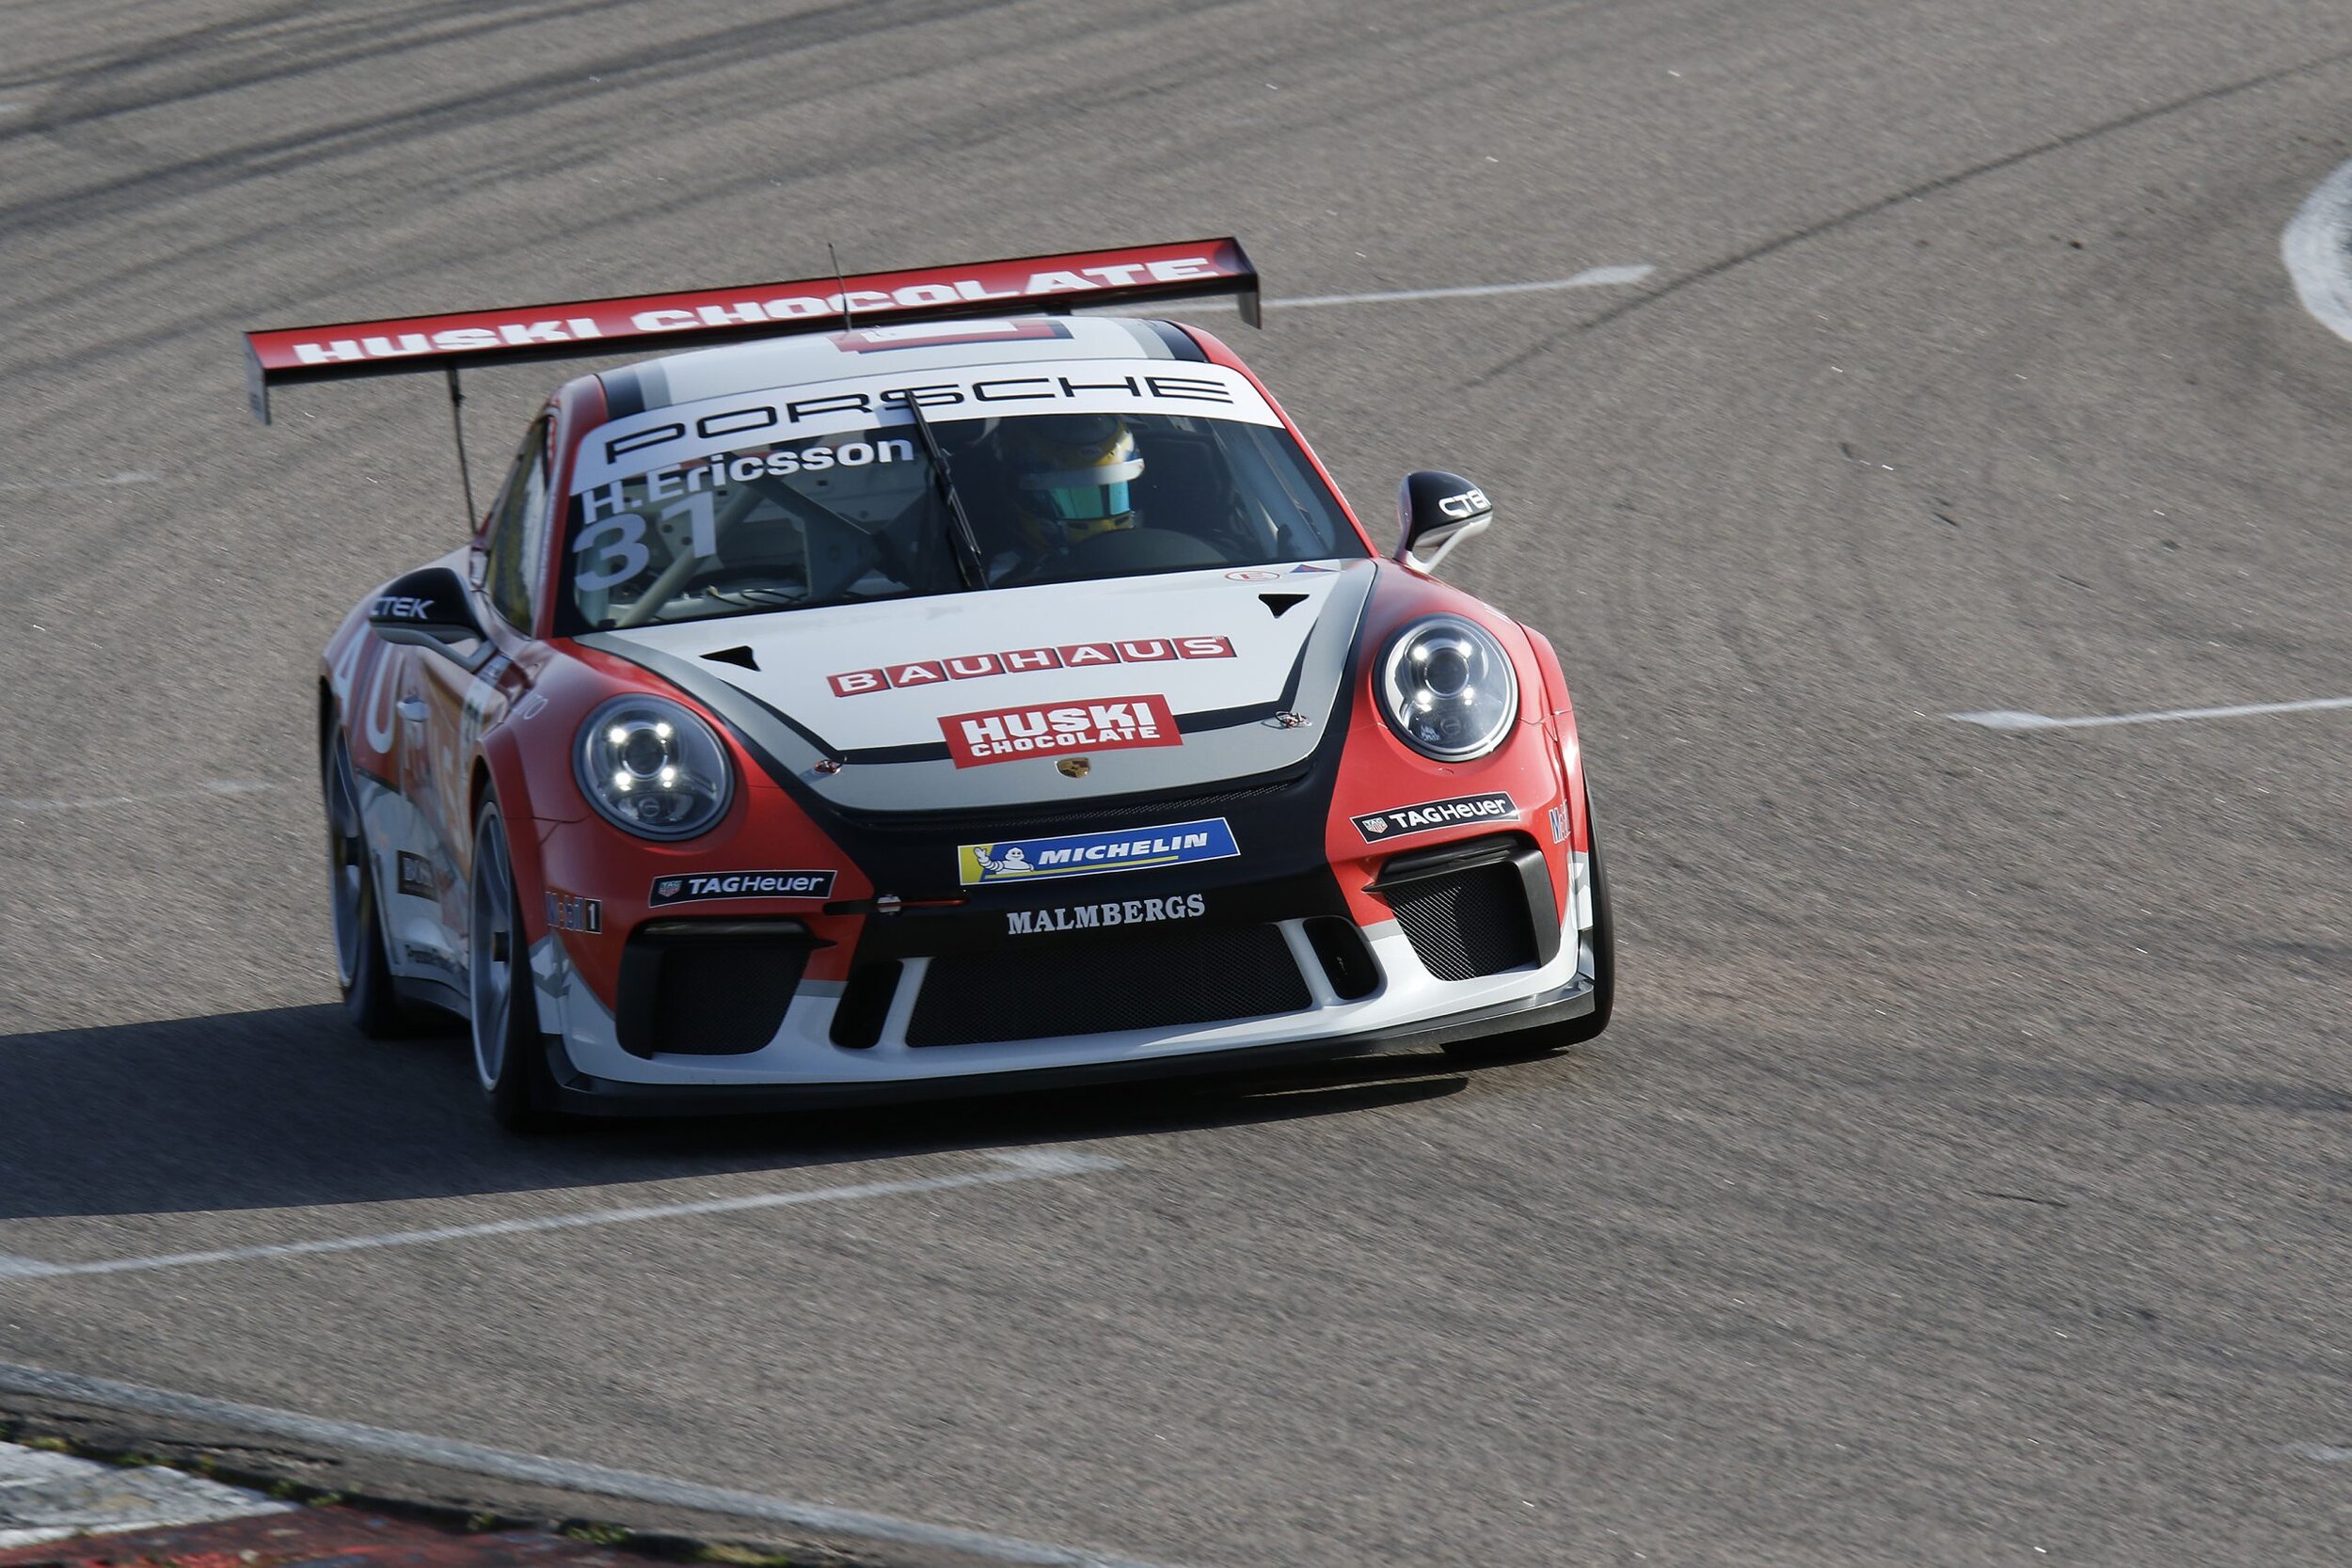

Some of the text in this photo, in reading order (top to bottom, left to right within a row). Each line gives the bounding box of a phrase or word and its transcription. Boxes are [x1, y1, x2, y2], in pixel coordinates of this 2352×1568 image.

[294, 257, 1220, 365] HUSKI CHOCOLATE
[605, 375, 1234, 466] PORSCHE
[572, 490, 718, 593] 31
[835, 638, 1226, 692] BAUHAUS
[960, 702, 1156, 745] HUSKI
[970, 724, 1161, 757] CHOCOLATE
[1038, 832, 1209, 865] MICHELIN
[1007, 894, 1206, 935] MALMBERGS
